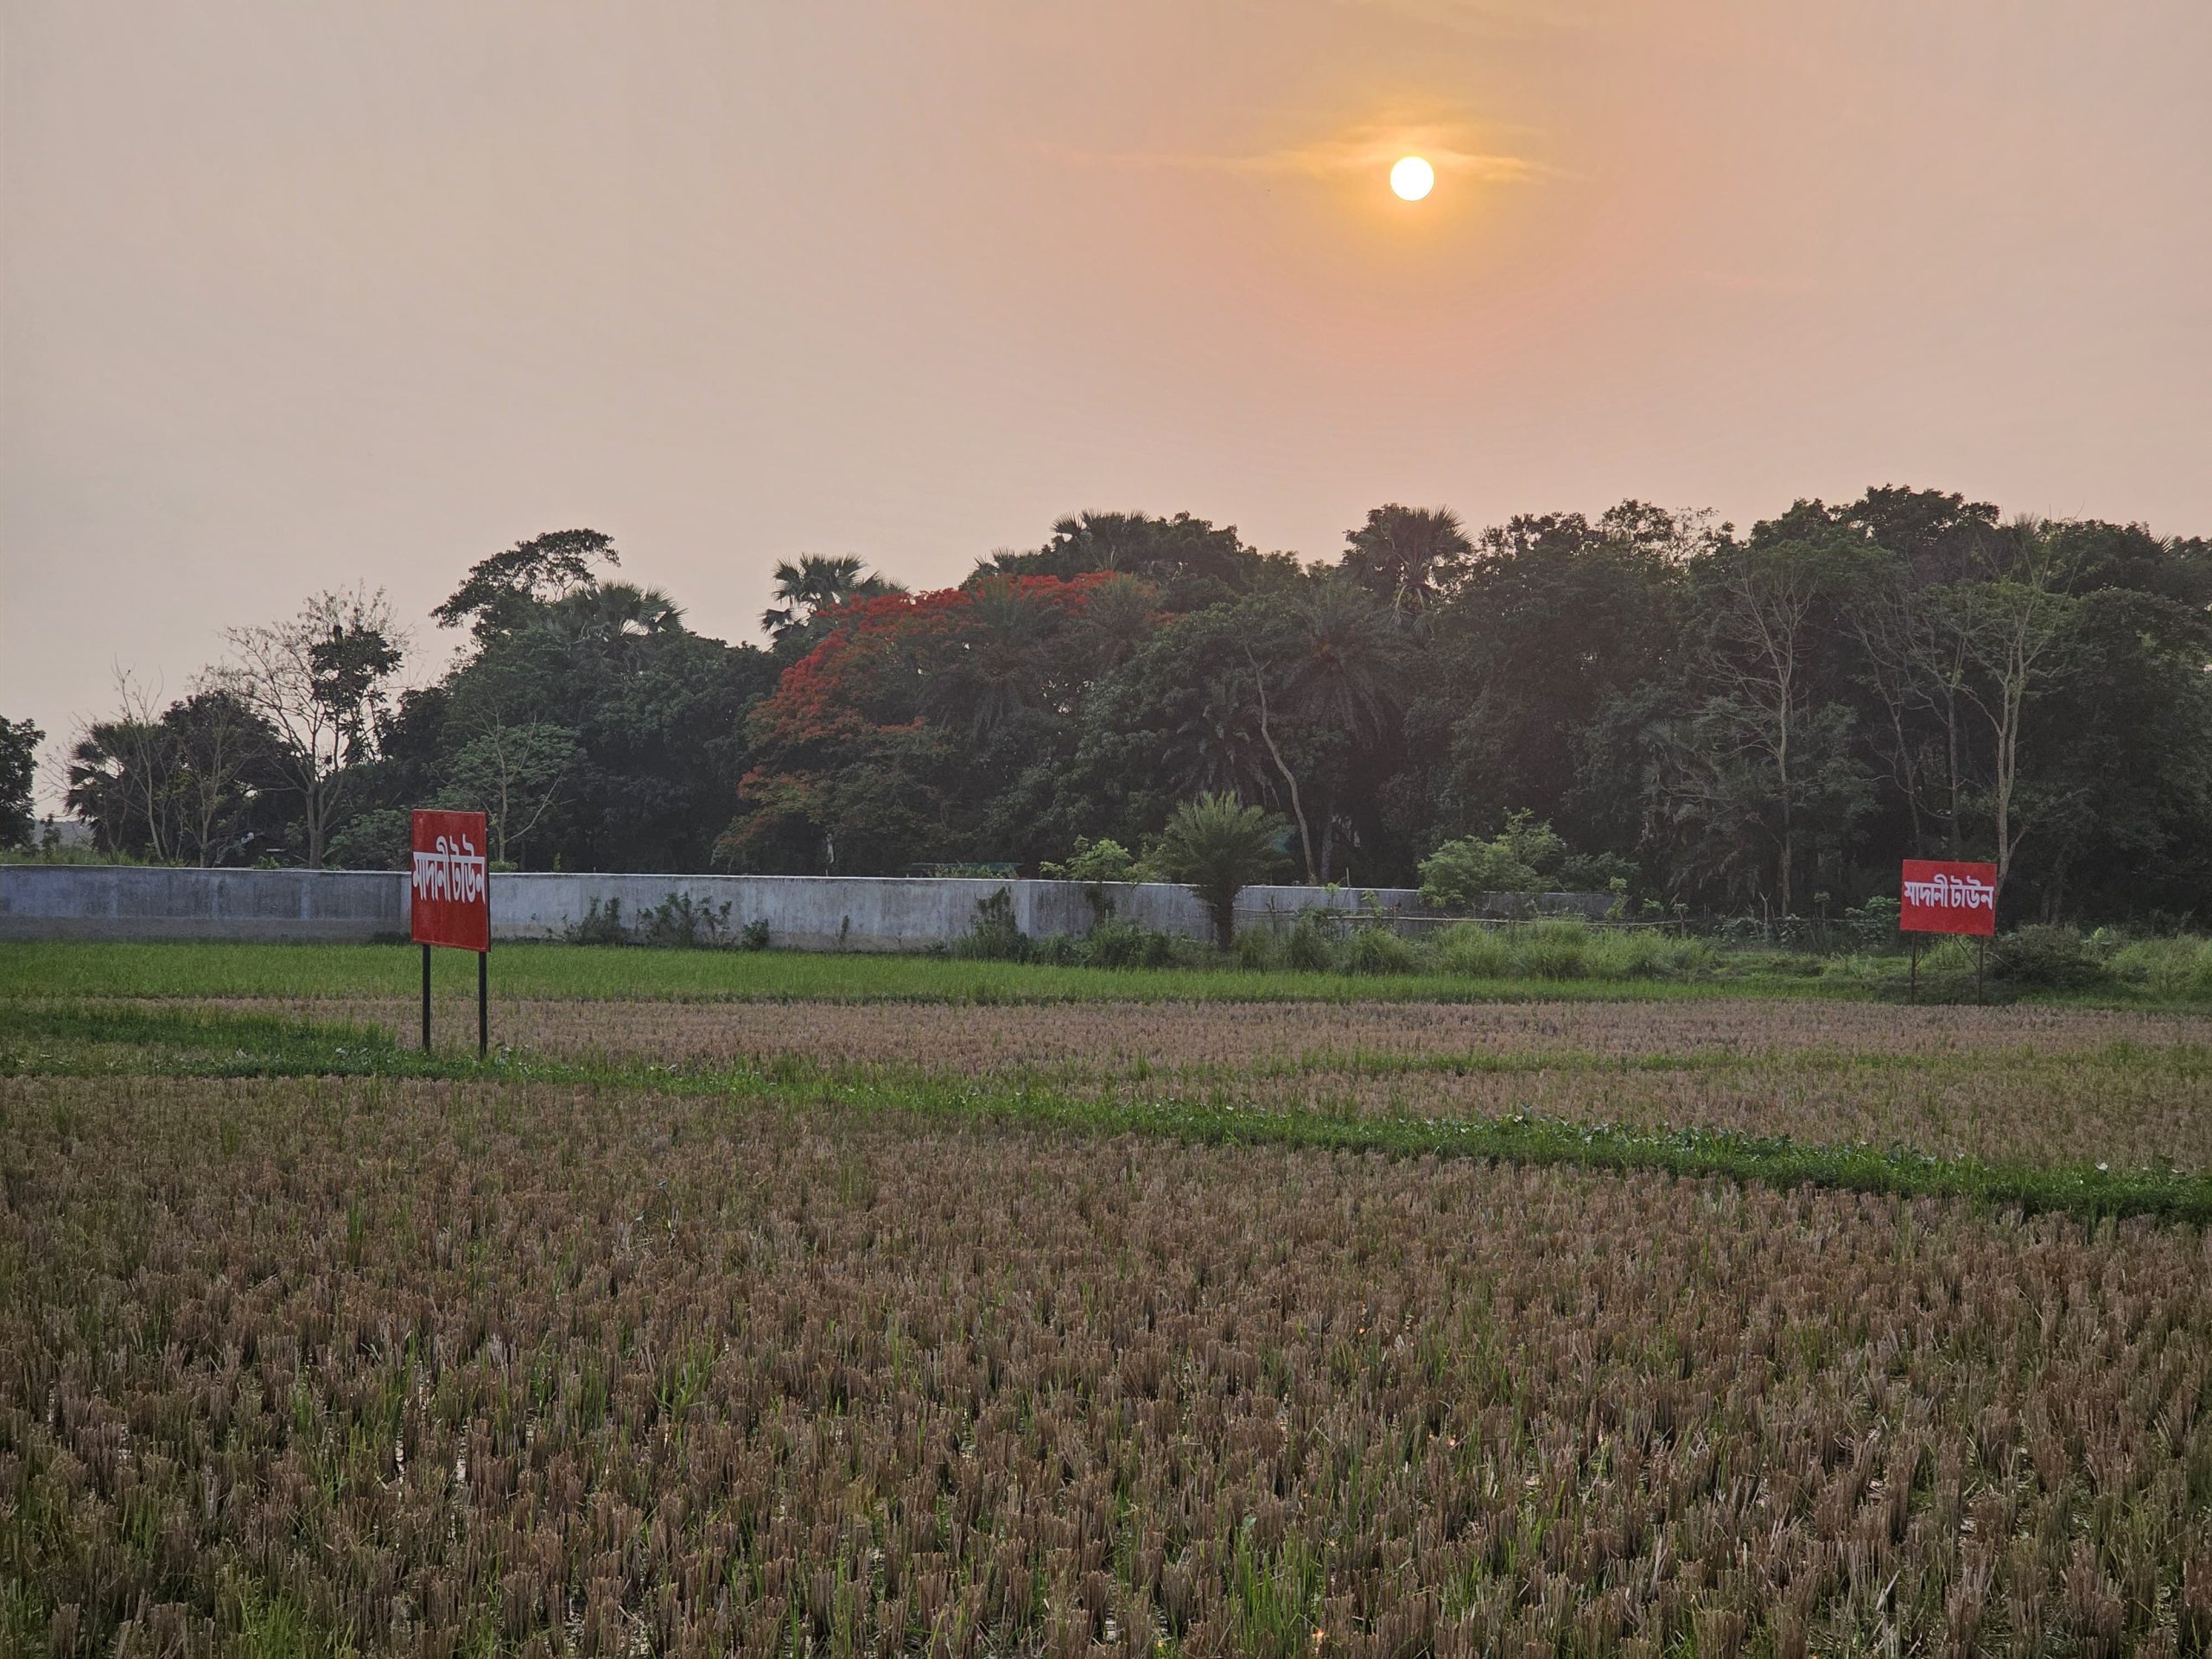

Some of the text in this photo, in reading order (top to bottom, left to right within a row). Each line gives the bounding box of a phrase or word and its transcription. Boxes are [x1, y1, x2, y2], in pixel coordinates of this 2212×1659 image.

[412, 832, 486, 906] মাদানী টাউন
[1904, 873, 1994, 911] মাদানী টাউন
